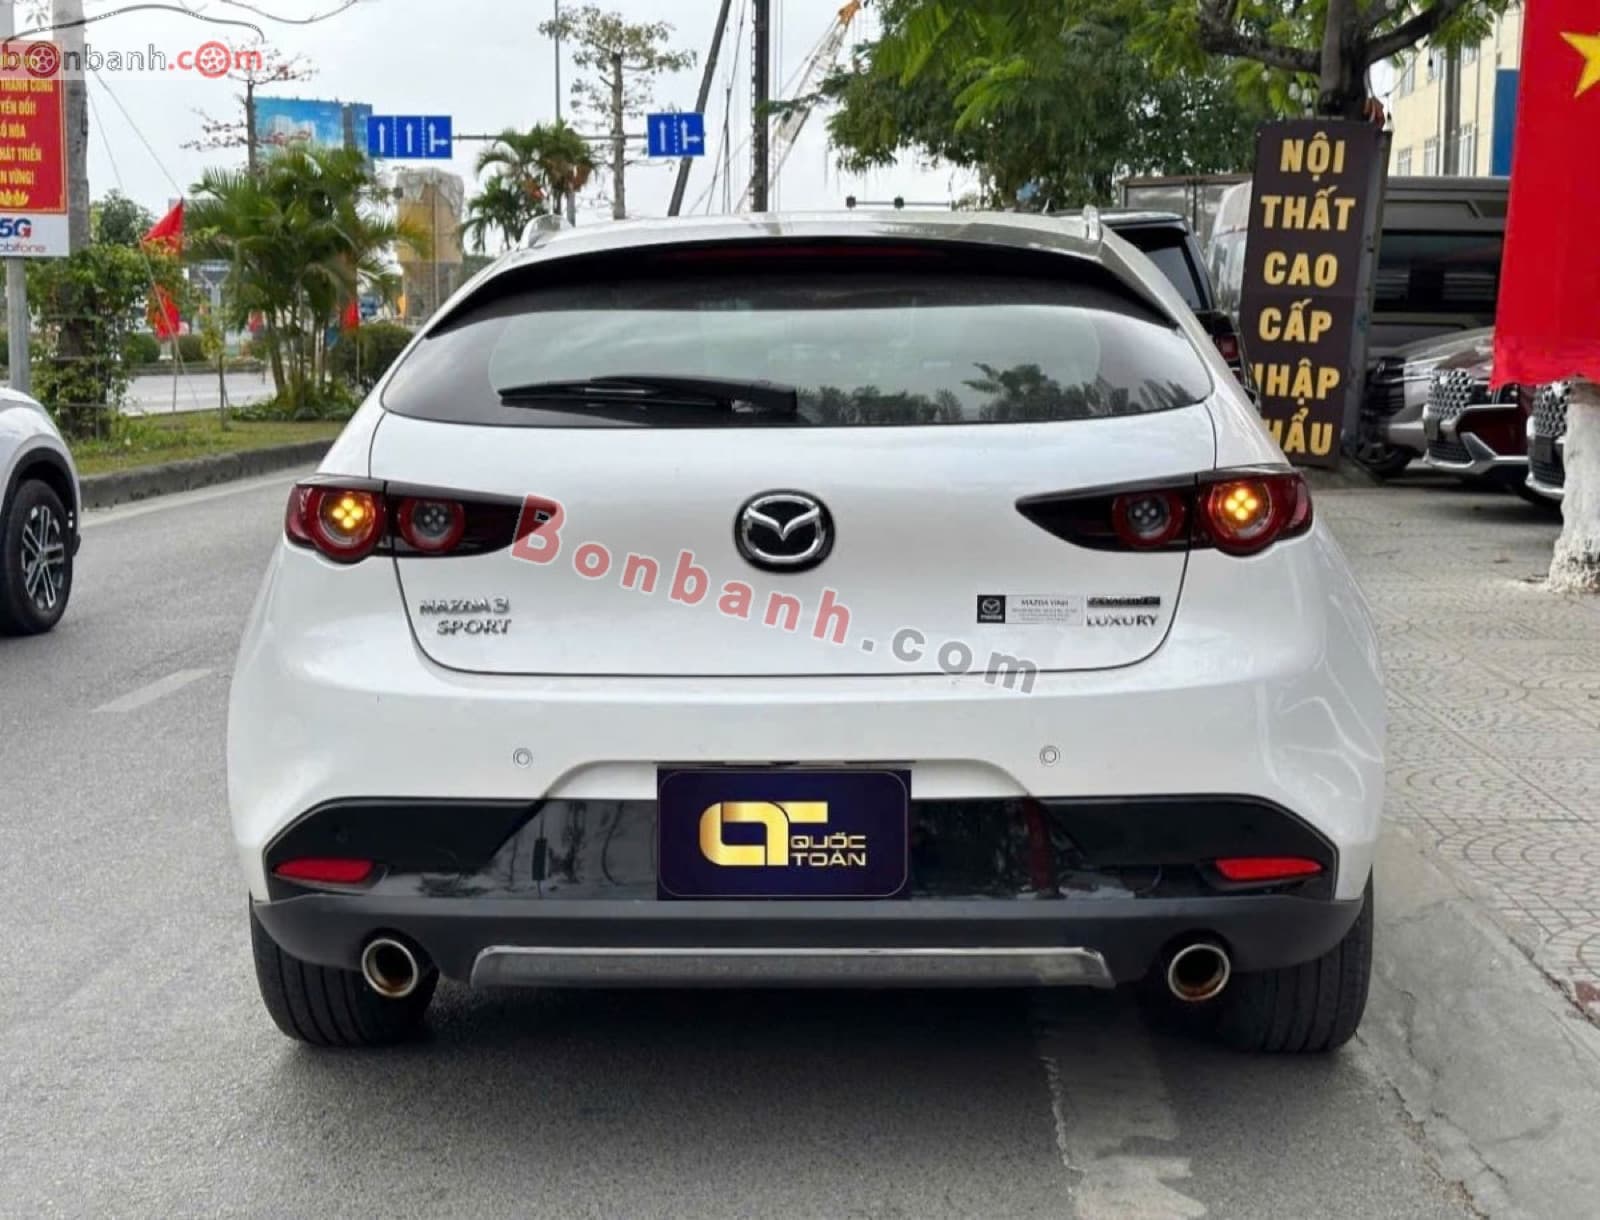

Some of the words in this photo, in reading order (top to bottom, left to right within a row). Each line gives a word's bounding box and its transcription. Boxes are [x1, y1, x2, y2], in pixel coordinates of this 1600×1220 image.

[1280, 131, 1345, 181] NỘI
[1261, 185, 1356, 231] THẤT
[1263, 251, 1339, 288] CAO
[1259, 299, 1333, 343] CẤP
[436, 618, 512, 636] SPORT
[1086, 614, 1160, 627] LUXURY
[791, 832, 866, 849] QUỐC
